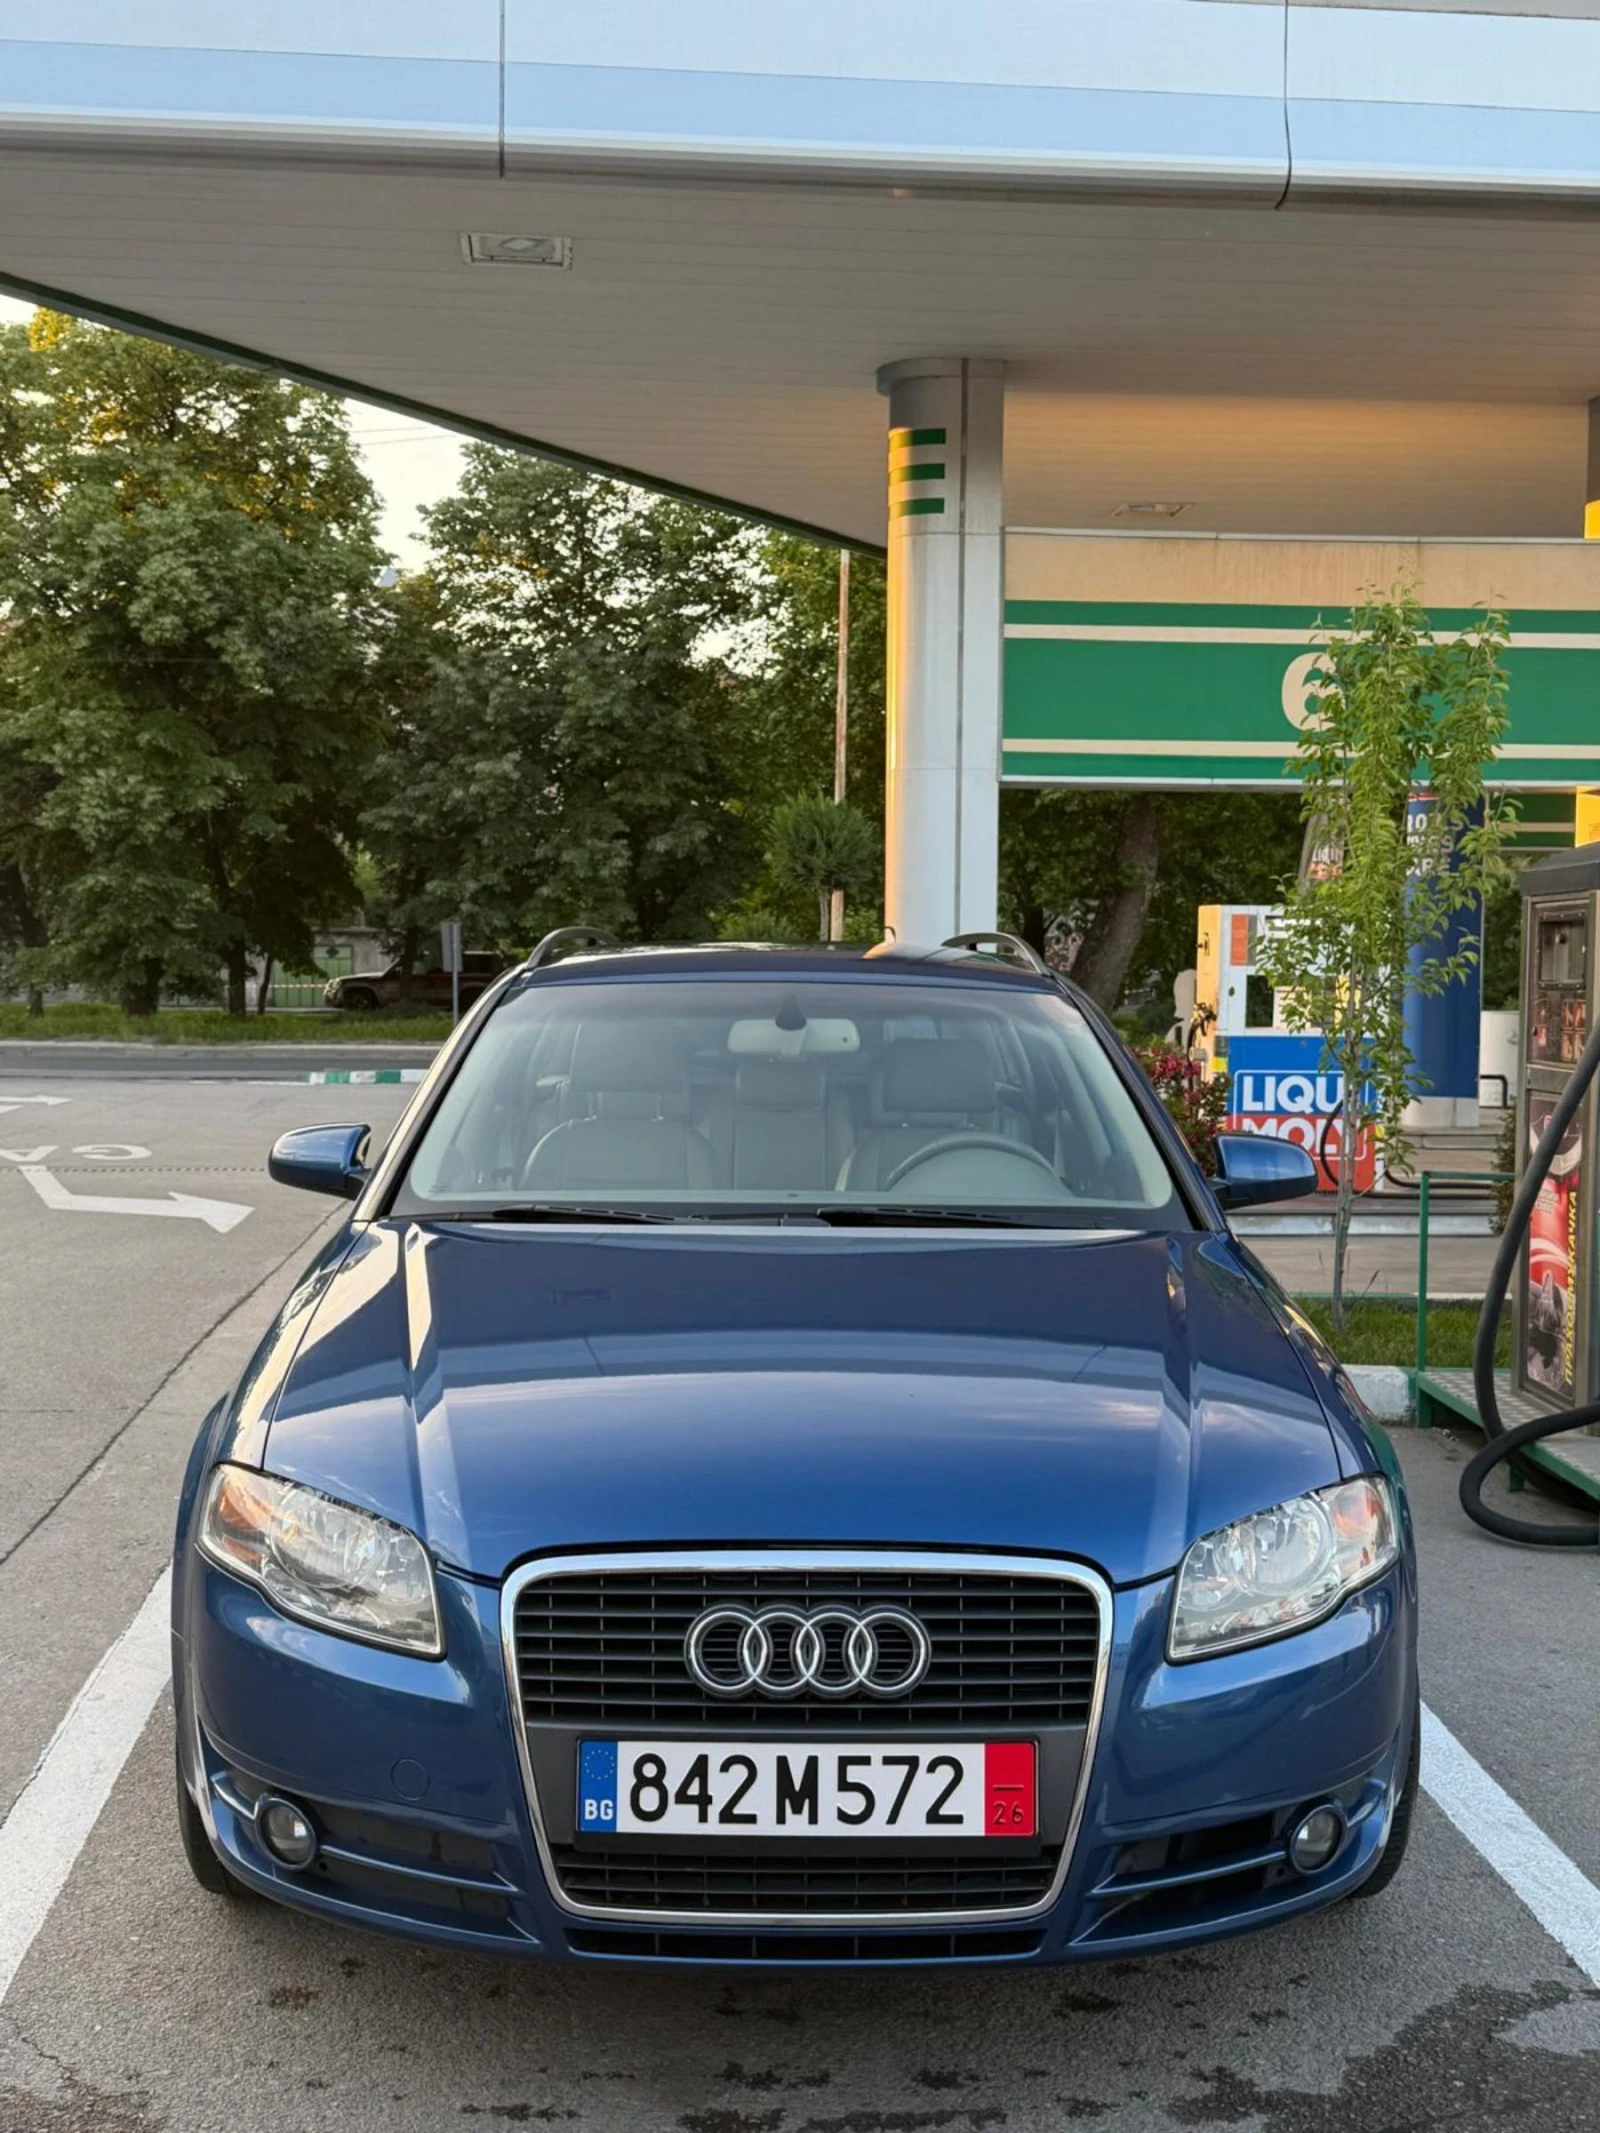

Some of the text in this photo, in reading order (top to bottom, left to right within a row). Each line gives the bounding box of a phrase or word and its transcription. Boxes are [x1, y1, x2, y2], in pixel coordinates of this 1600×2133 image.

[1282, 652, 1346, 732] 6
[1242, 1075, 1356, 1114] LIQU
[629, 1753, 964, 1826] 842 M 572
[584, 1800, 614, 1821] BG
[993, 1800, 1024, 1824] 26
